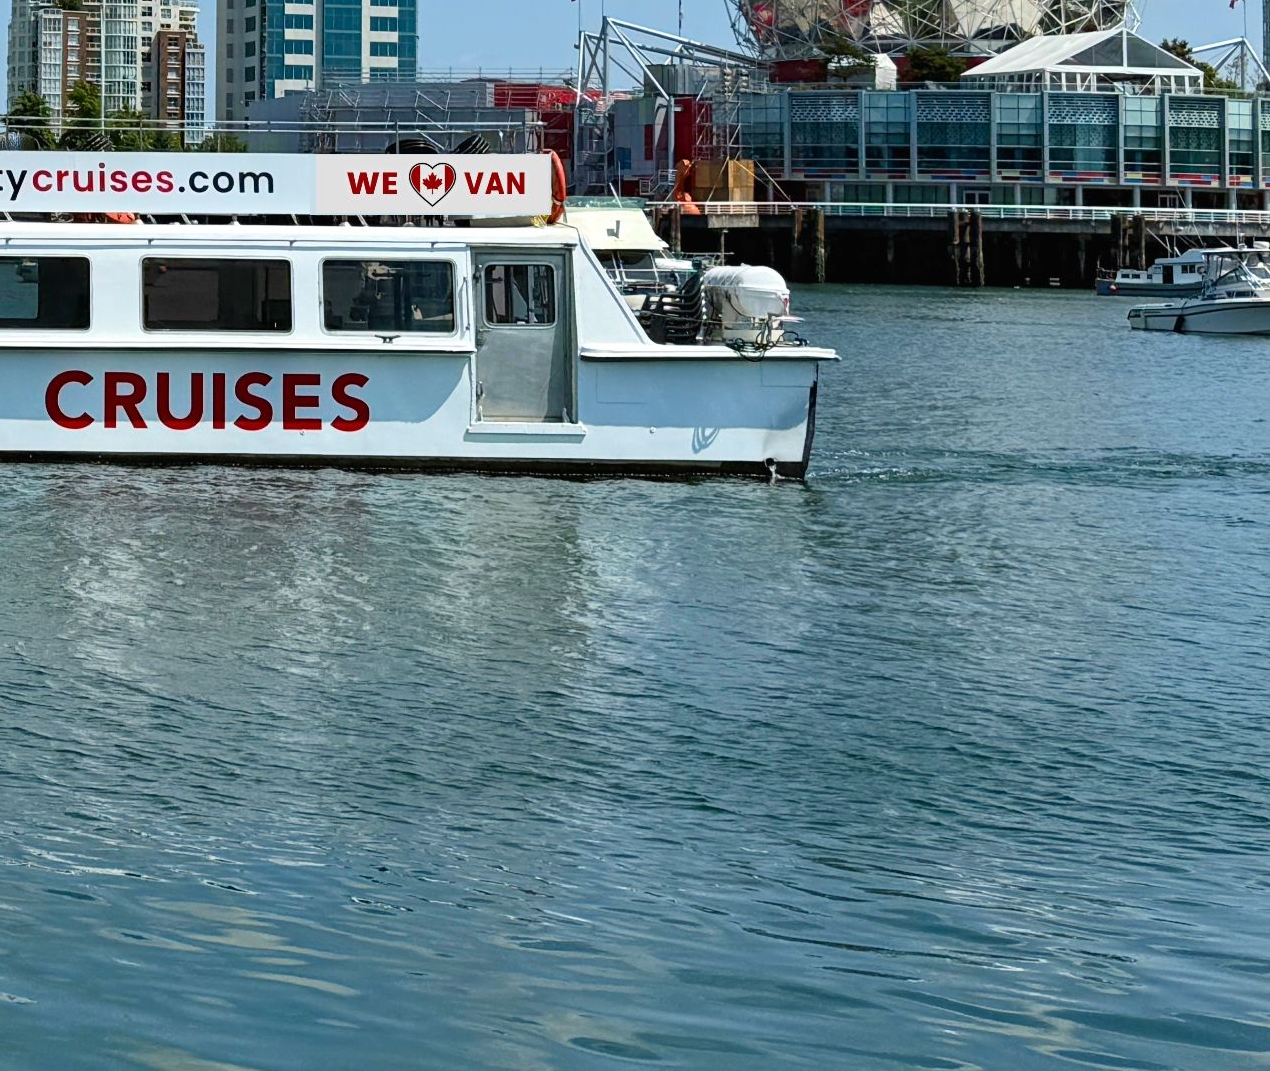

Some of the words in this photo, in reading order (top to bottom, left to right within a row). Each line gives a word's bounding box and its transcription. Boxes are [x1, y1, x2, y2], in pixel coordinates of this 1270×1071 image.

[346, 171, 399, 195] WE
[463, 171, 527, 195] VAN
[44, 370, 371, 433] CRUISES
